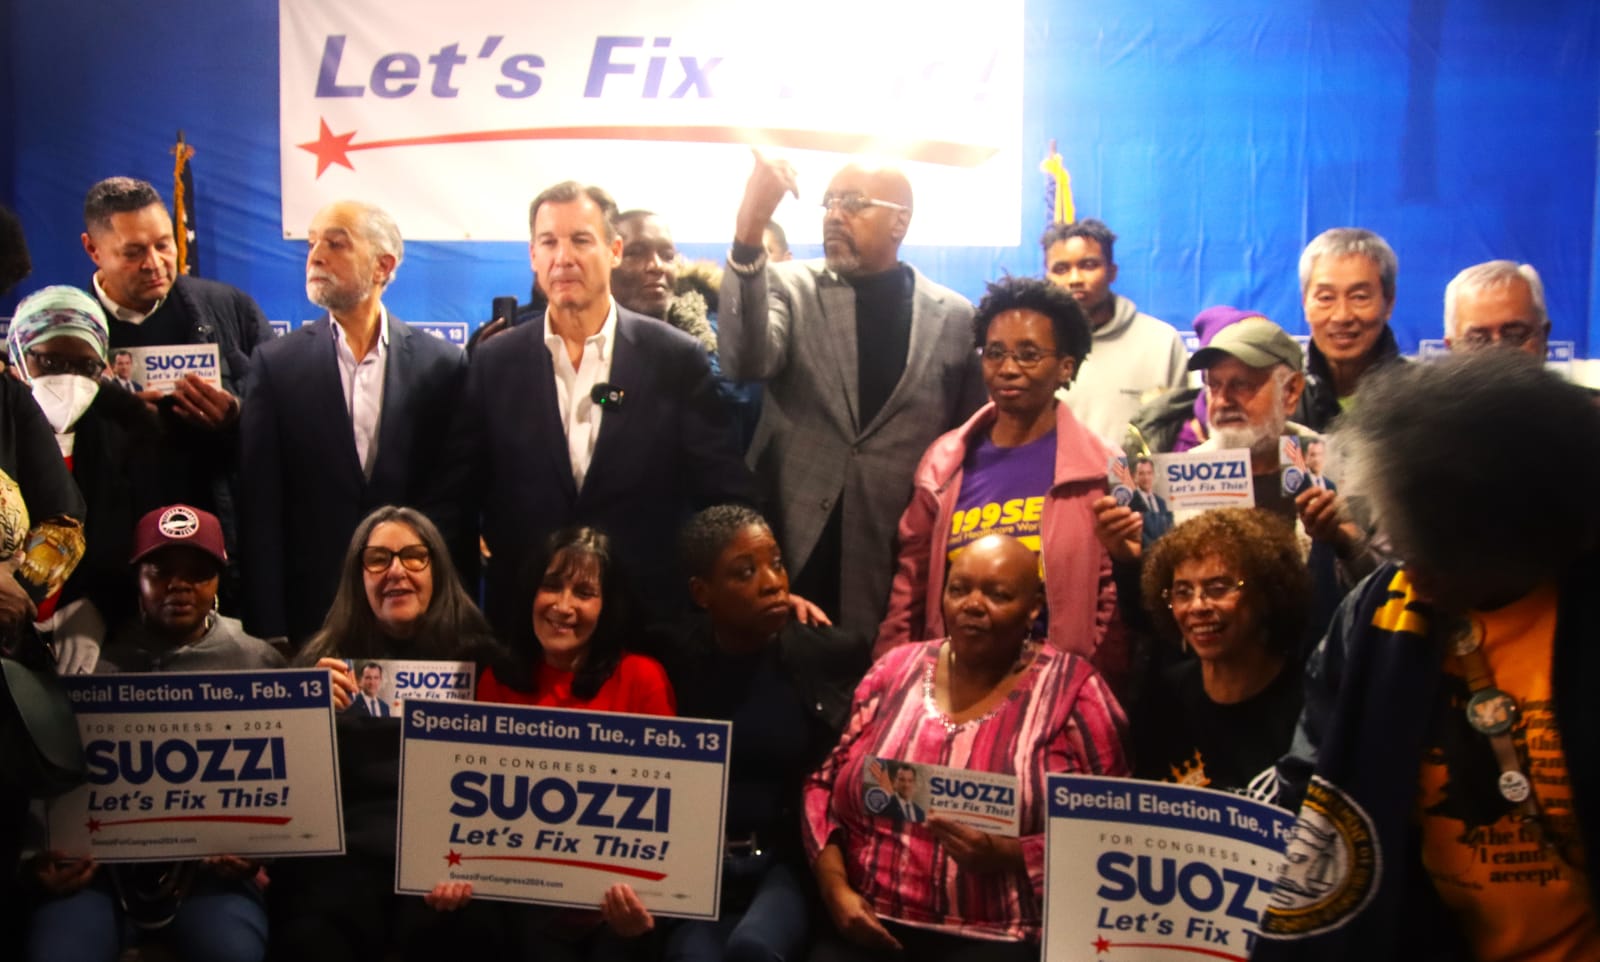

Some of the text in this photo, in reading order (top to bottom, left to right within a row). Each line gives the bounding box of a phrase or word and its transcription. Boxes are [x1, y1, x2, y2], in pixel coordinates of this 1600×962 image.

[314, 34, 546, 99] Let's
[583, 36, 724, 99] Fix
[145, 354, 215, 371] SUOZZI
[1168, 460, 1247, 483] SUOZZI
[1169, 483, 1196, 493] Let's
[1200, 483, 1215, 492] Fix
[68, 679, 323, 702] ecial Election Tue., Feb. 13
[395, 671, 471, 689] SUOZZI
[86, 720, 283, 735] FOR CONGRESS 2024
[411, 710, 720, 751] Special Election Tue., Feb. 13
[84, 737, 287, 785] SUOZZI
[454, 754, 672, 780] FOR CONGRESS 2024
[88, 787, 290, 812] Let's Fix This!
[449, 770, 672, 834] SUOZZI
[929, 776, 1015, 806] SUOZZI
[929, 797, 960, 810] Let's
[962, 801, 980, 813] Fix
[1055, 787, 1131, 811] Special
[1138, 793, 1221, 823] Election
[1226, 806, 1268, 838] Tue.,
[449, 823, 670, 862] Let's Fix This!
[1100, 832, 1240, 864] FOR CONGRESS
[1096, 851, 1275, 924] SUOZ
[1097, 907, 1174, 936] Let's
[1186, 917, 1230, 946] Fix
